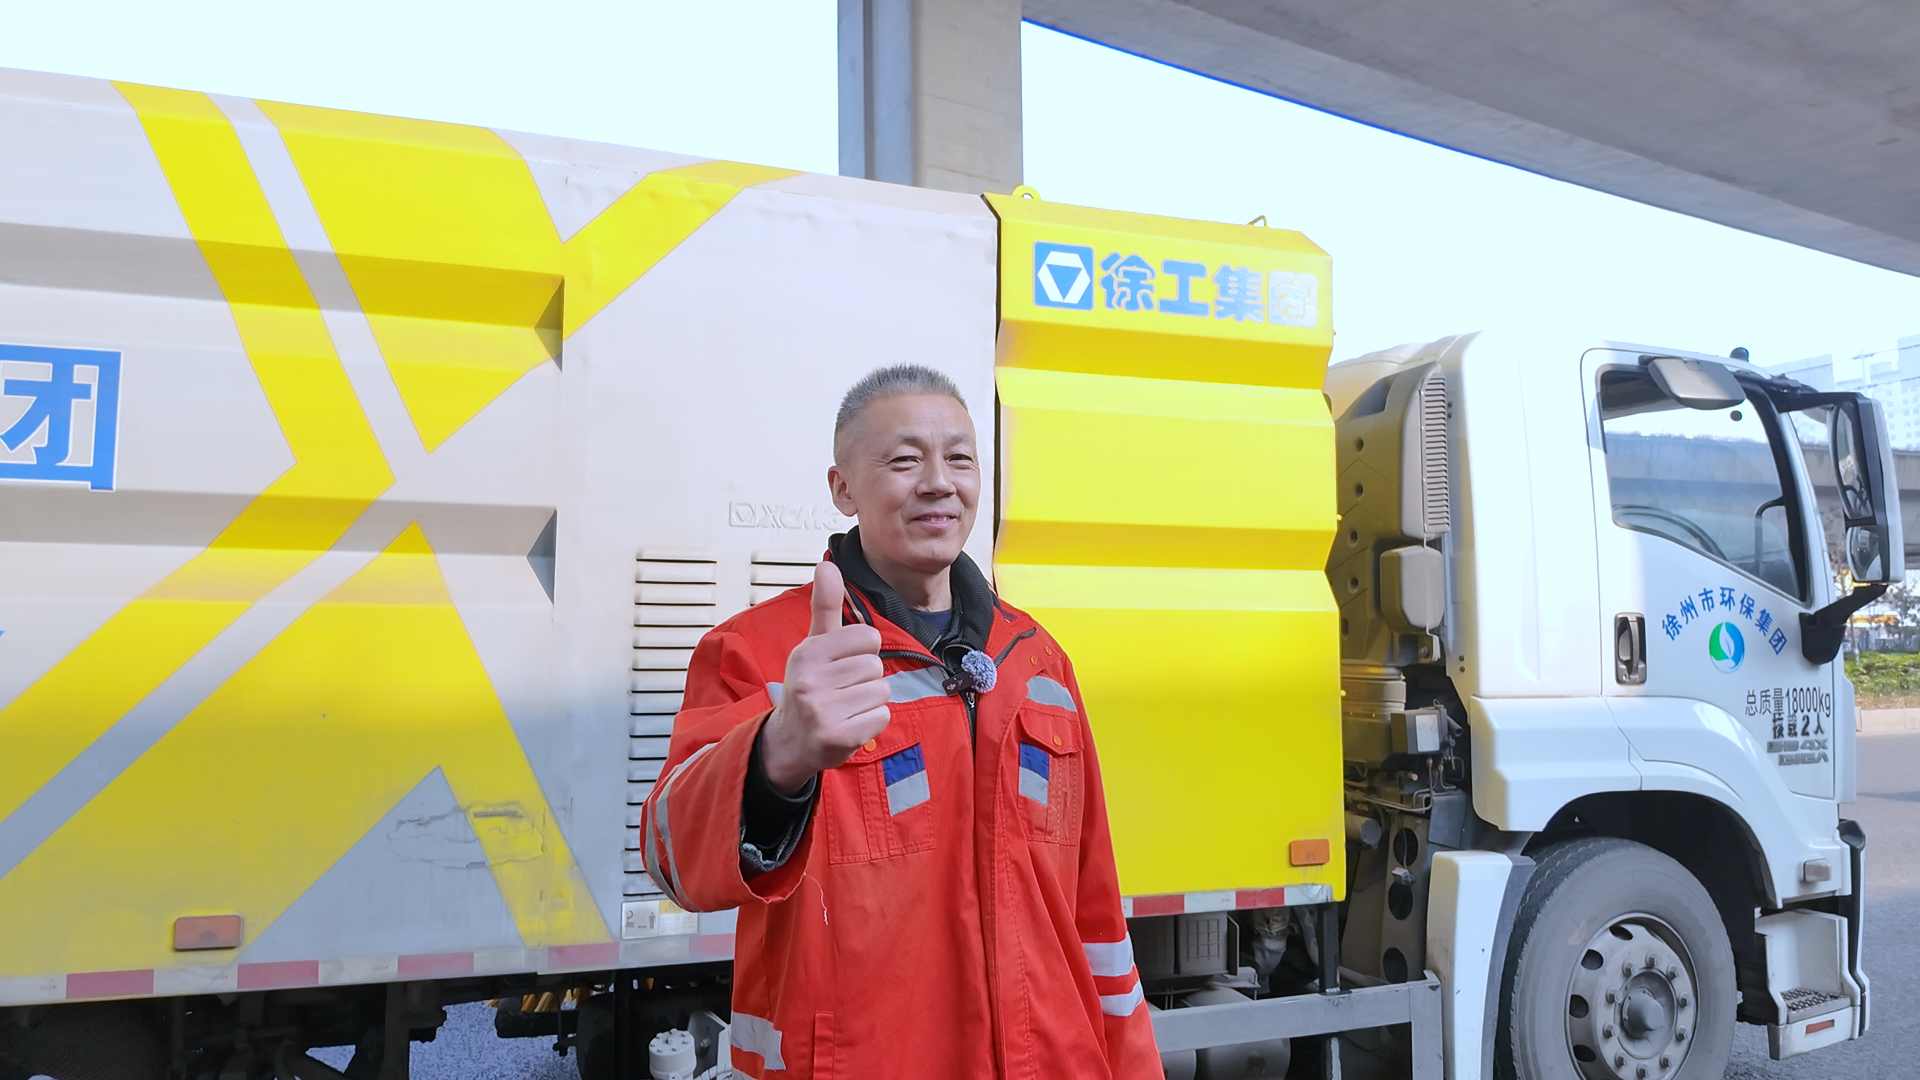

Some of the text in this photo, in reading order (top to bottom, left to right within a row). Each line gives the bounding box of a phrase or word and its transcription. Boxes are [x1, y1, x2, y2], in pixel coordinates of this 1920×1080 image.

[0, 343, 122, 491] 团
[1661, 586, 1788, 656] 徐州市环保集团
[1744, 686, 1831, 718] 总质量18000kg
